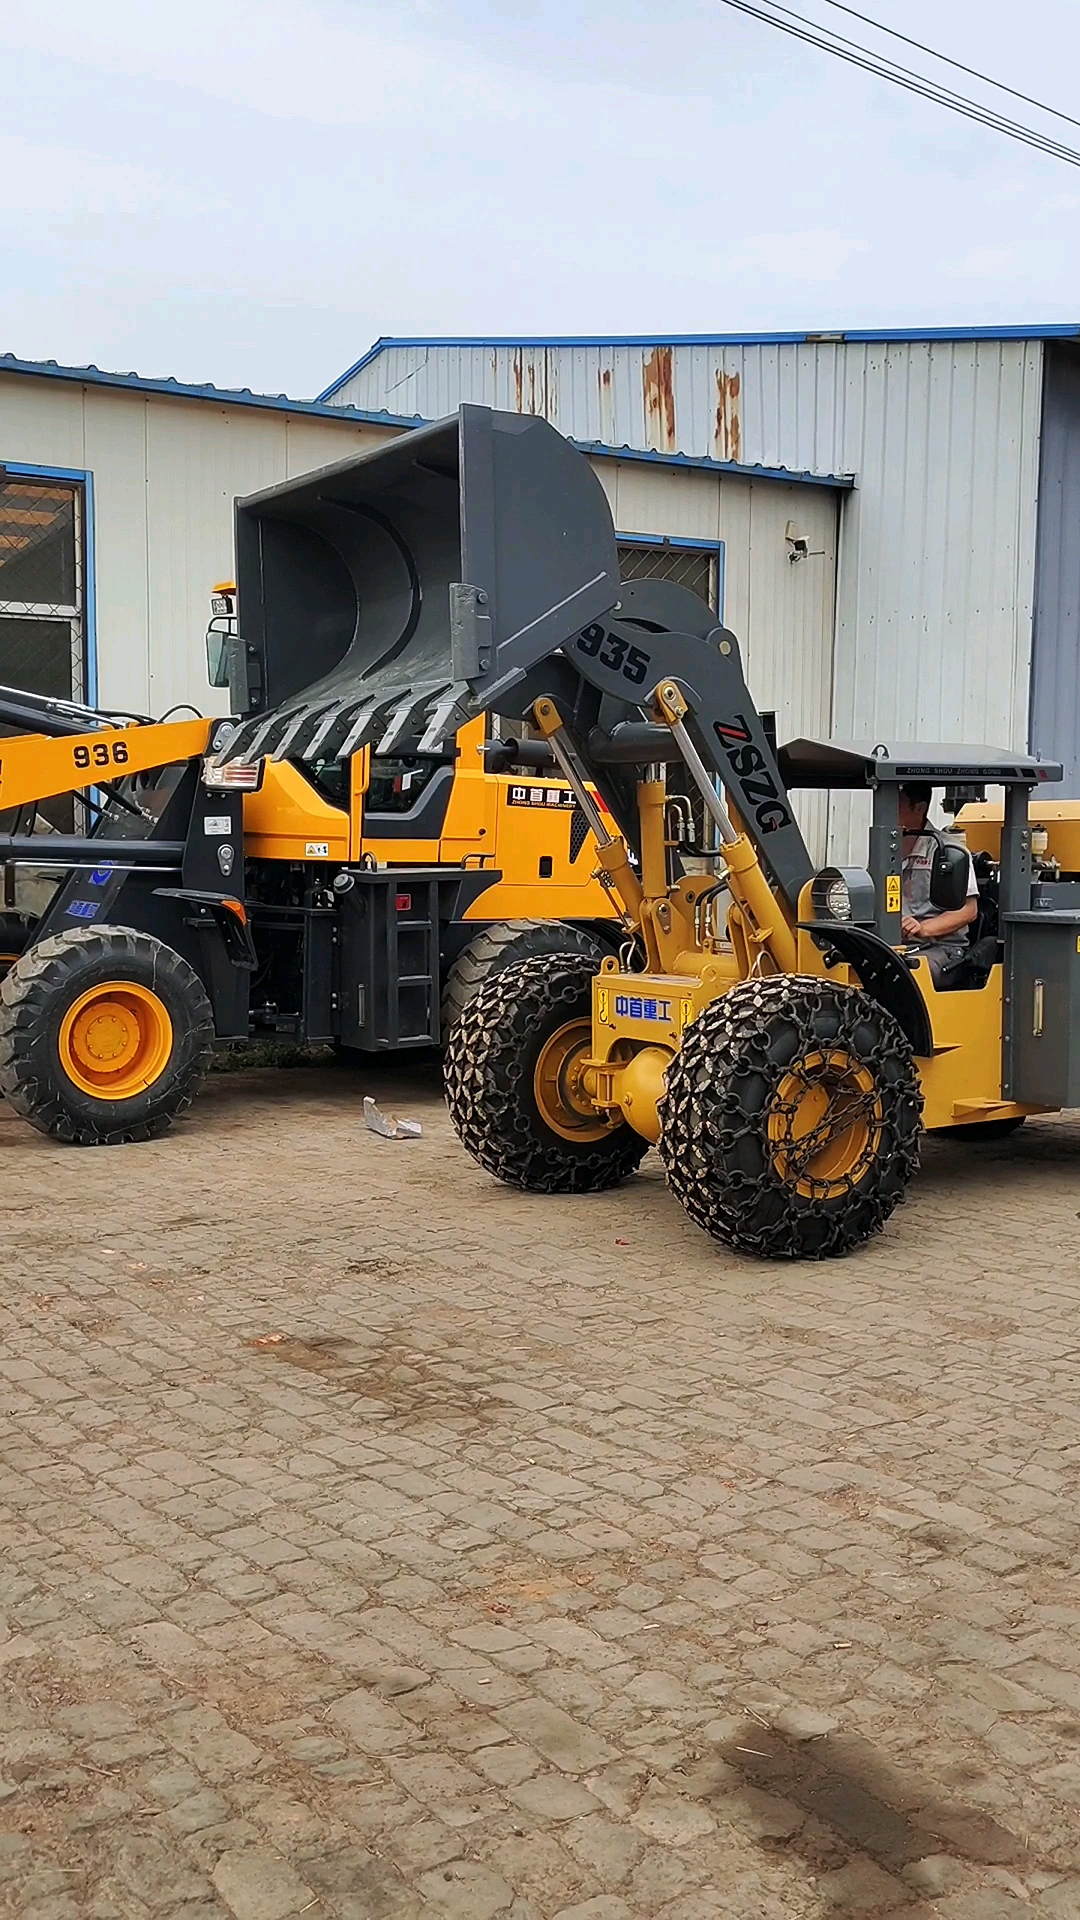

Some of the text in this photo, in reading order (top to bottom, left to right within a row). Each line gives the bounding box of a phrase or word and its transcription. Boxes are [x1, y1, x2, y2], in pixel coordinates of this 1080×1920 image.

[576, 622, 652, 685] 935
[72, 741, 129, 769] 936
[712, 714, 792, 835] ZSZG
[906, 767, 931, 775] ZHONG
[956, 768, 980, 776] ZHONG
[512, 786, 577, 804] 中首重工
[615, 995, 672, 1021] 中首重工
